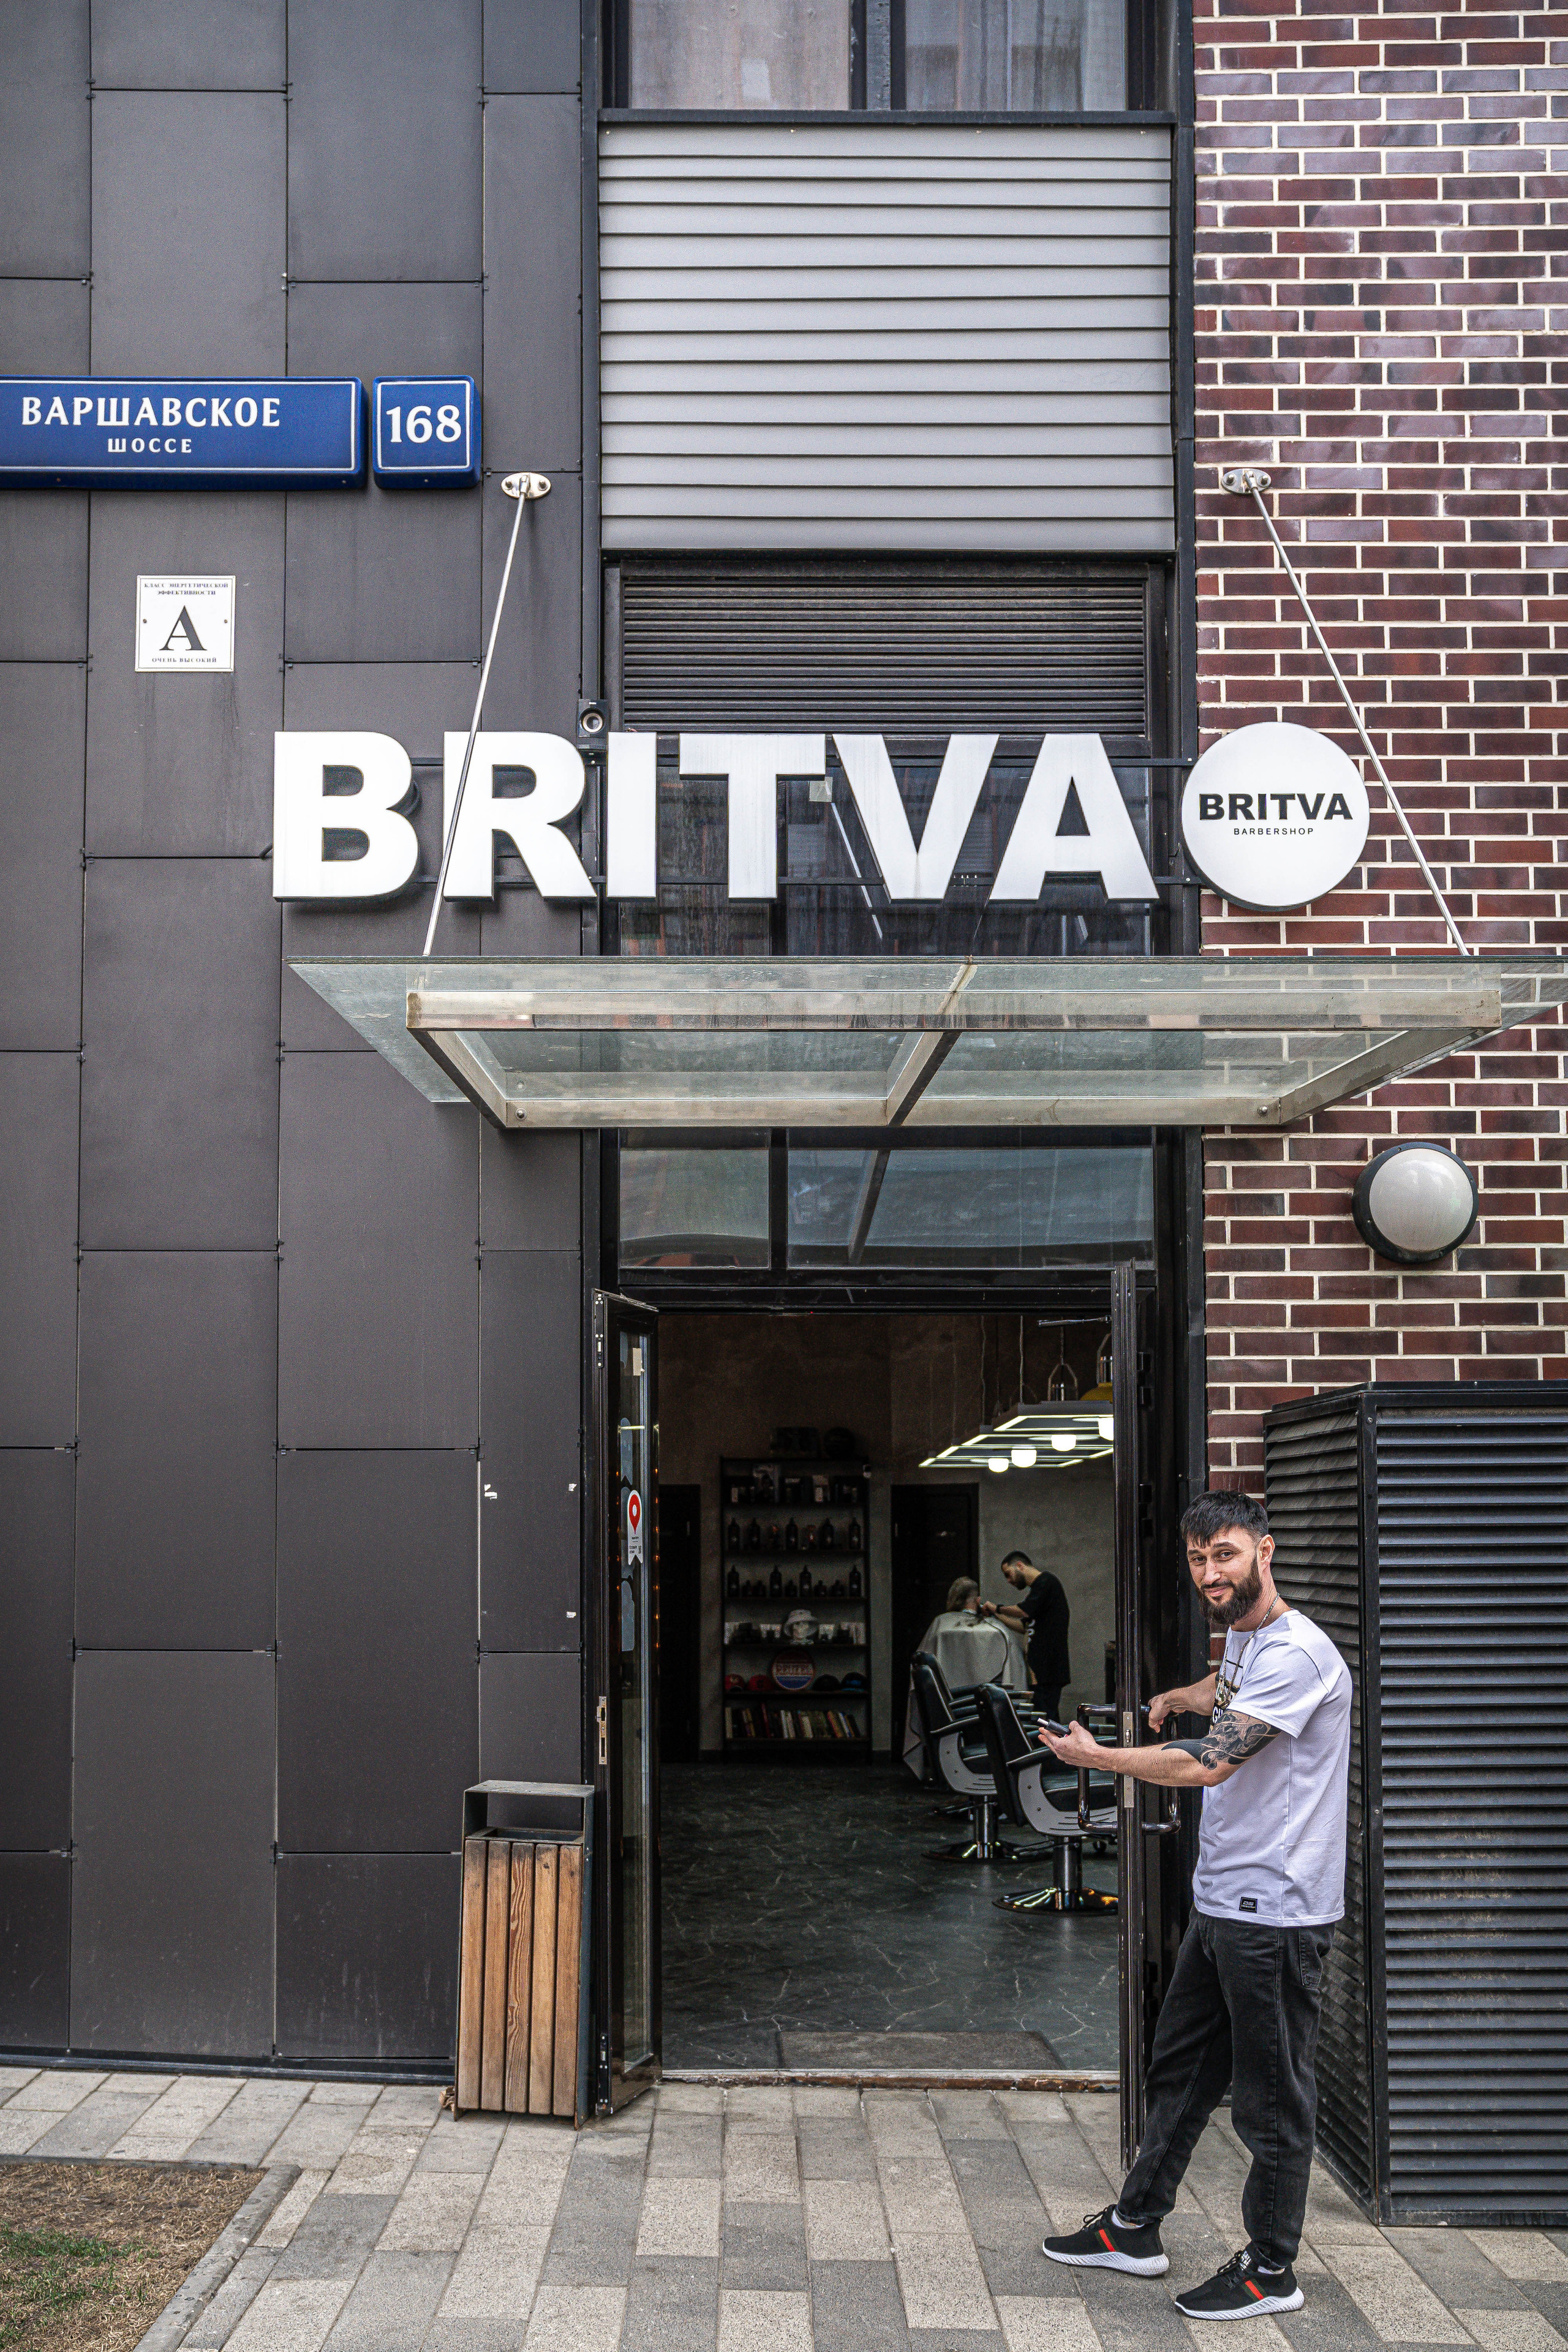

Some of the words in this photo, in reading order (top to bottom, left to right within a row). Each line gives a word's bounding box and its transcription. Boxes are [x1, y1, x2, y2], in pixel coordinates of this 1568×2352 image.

[21, 396, 281, 428] ВАРШАВСКОЕ
[386, 404, 462, 443] 168
[107, 437, 192, 453] ШОССЕ
[273, 731, 1159, 902] BRITVA
[1199, 793, 1354, 821] BRITVA
